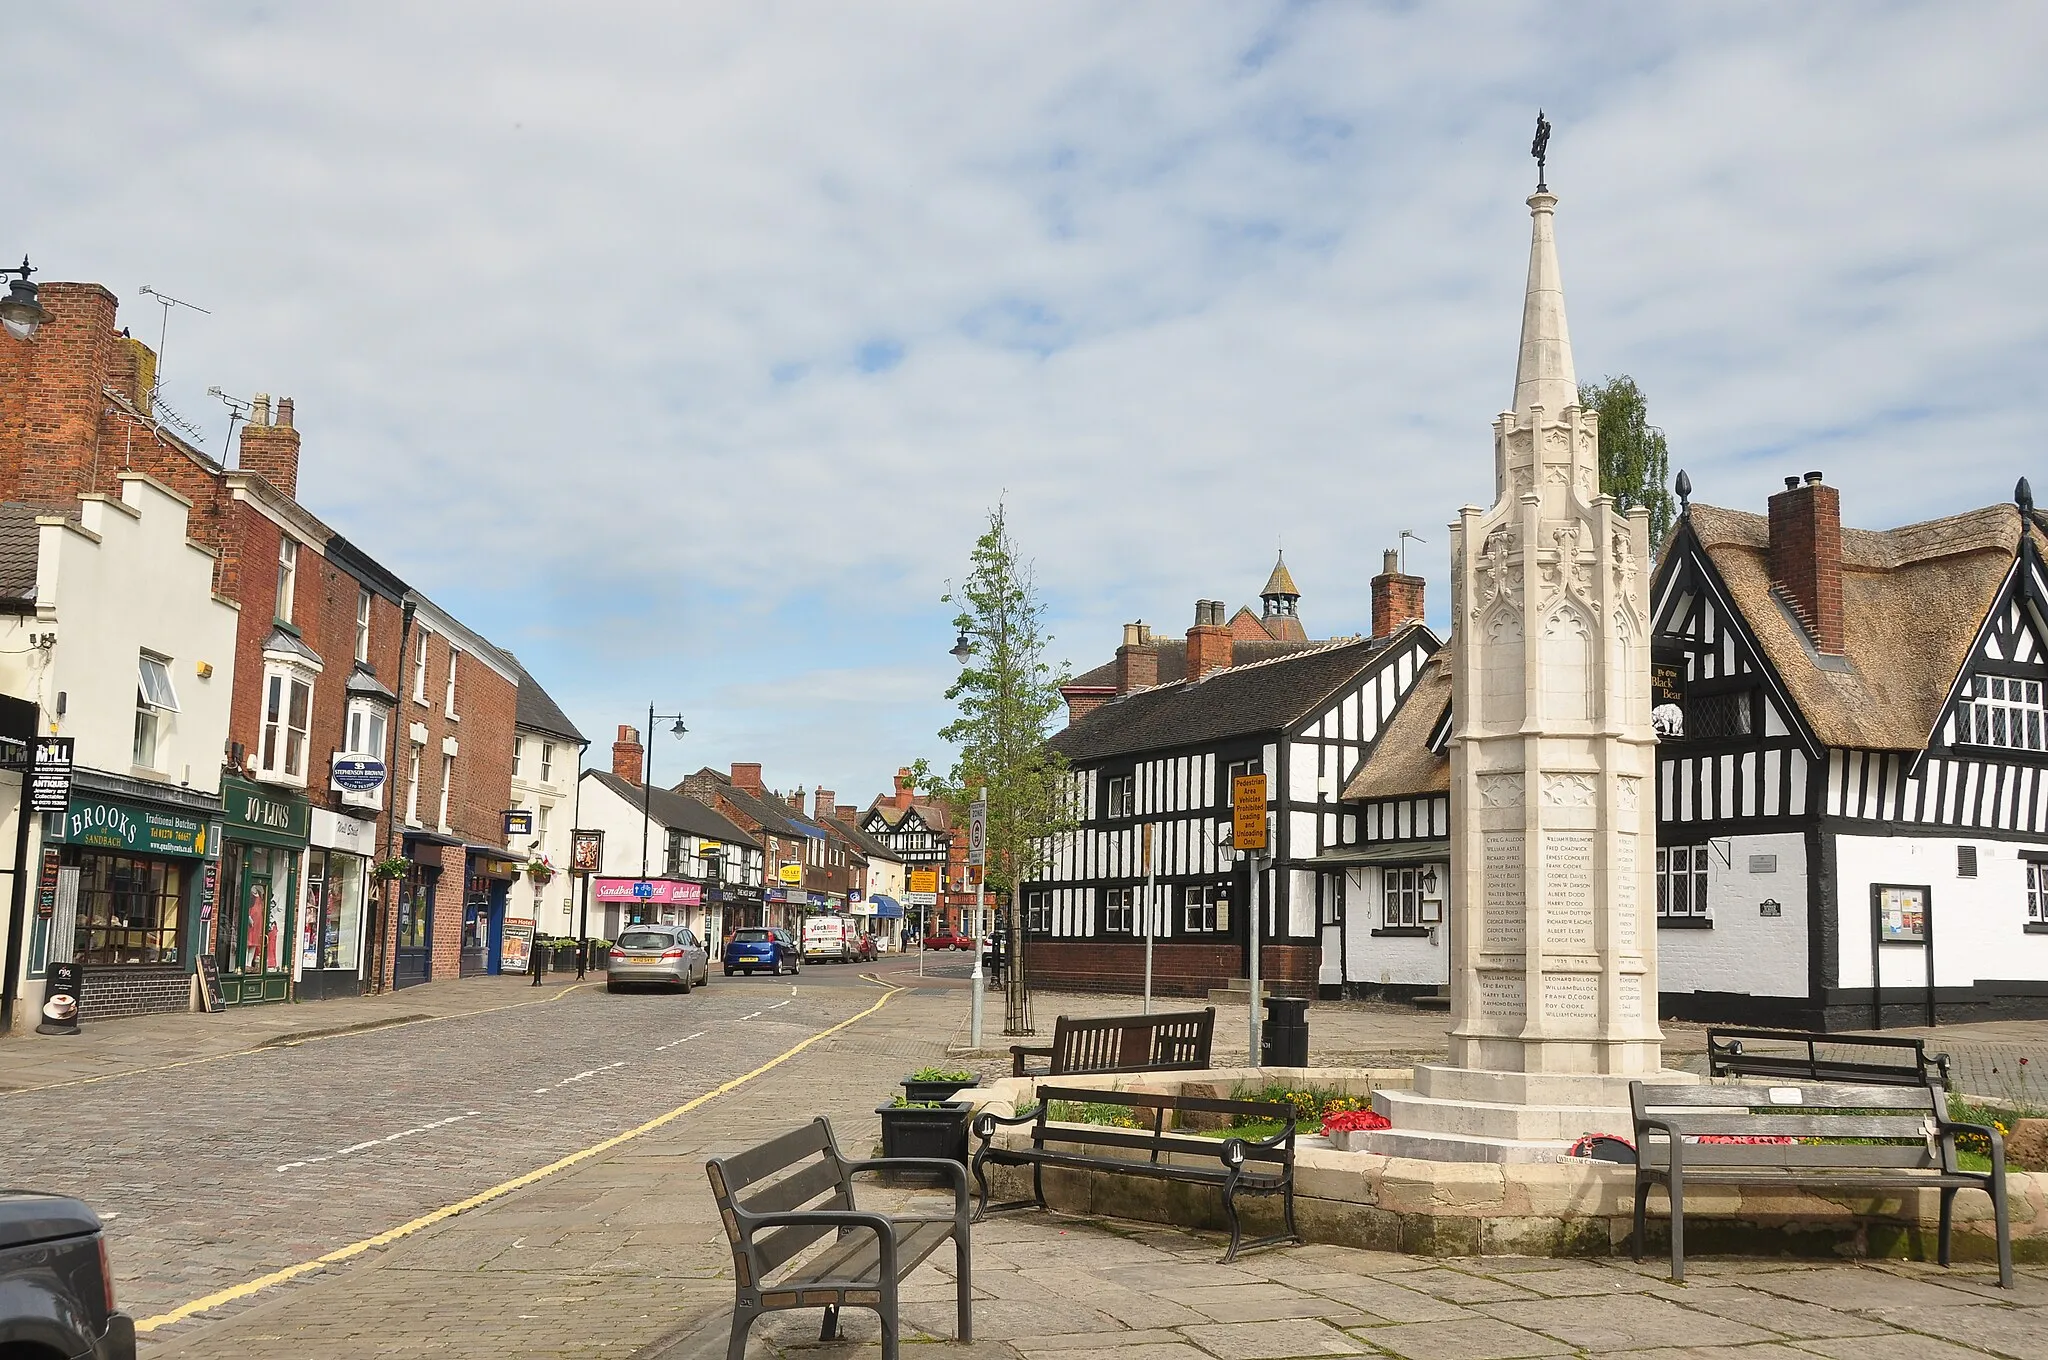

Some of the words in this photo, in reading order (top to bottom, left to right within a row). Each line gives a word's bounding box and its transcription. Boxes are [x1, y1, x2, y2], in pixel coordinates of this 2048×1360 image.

[1652, 676, 1673, 688] Black
[1663, 688, 1682, 700] Bear
[245, 796, 290, 829] JO-LINS
[72, 804, 137, 844] BROOKS
[145, 812, 174, 826] Traditional
[175, 817, 197, 830] Butchers
[101, 826, 108, 834] of
[510, 824, 526, 832] HILL
[84, 834, 122, 847] SANDBACH
[597, 886, 634, 897] Sandbac
